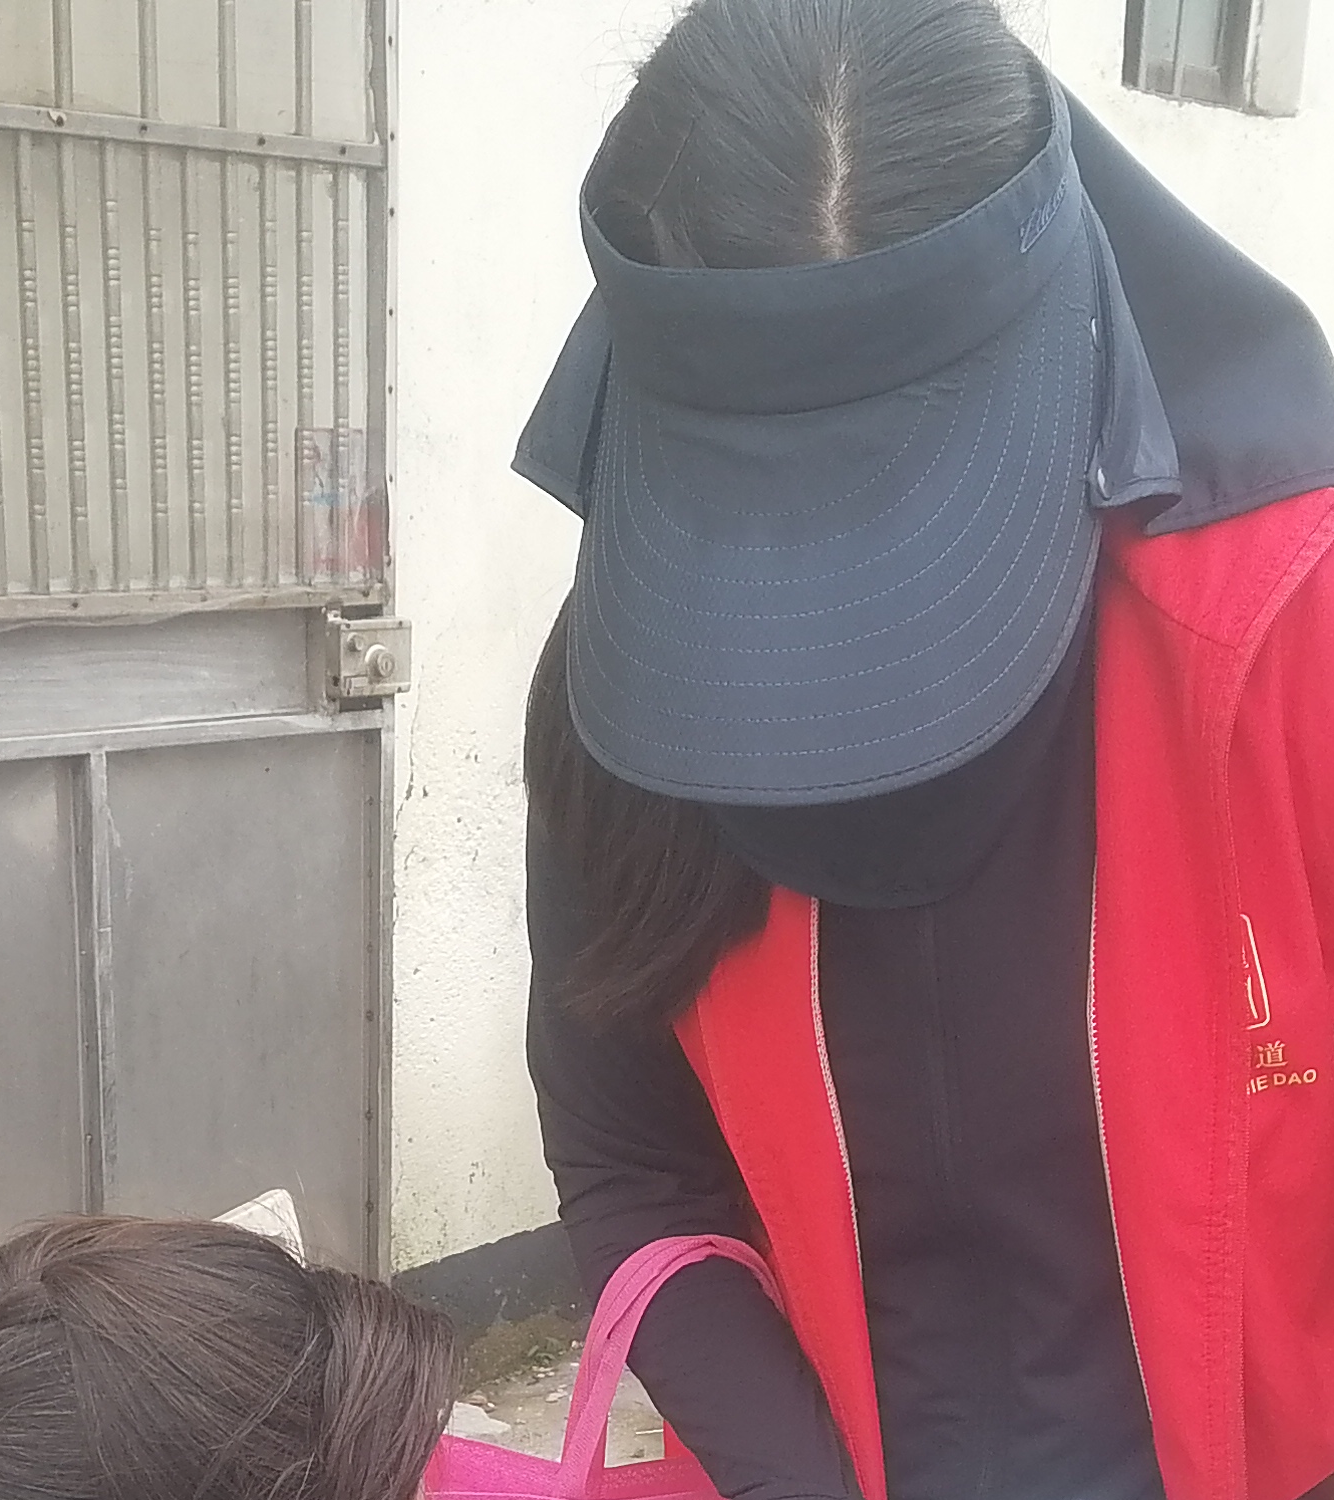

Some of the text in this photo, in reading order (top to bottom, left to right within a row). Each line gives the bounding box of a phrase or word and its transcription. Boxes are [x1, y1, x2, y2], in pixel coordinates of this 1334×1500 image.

[1255, 1041, 1288, 1069] 道
[1246, 1068, 1317, 1095] IE DAO
